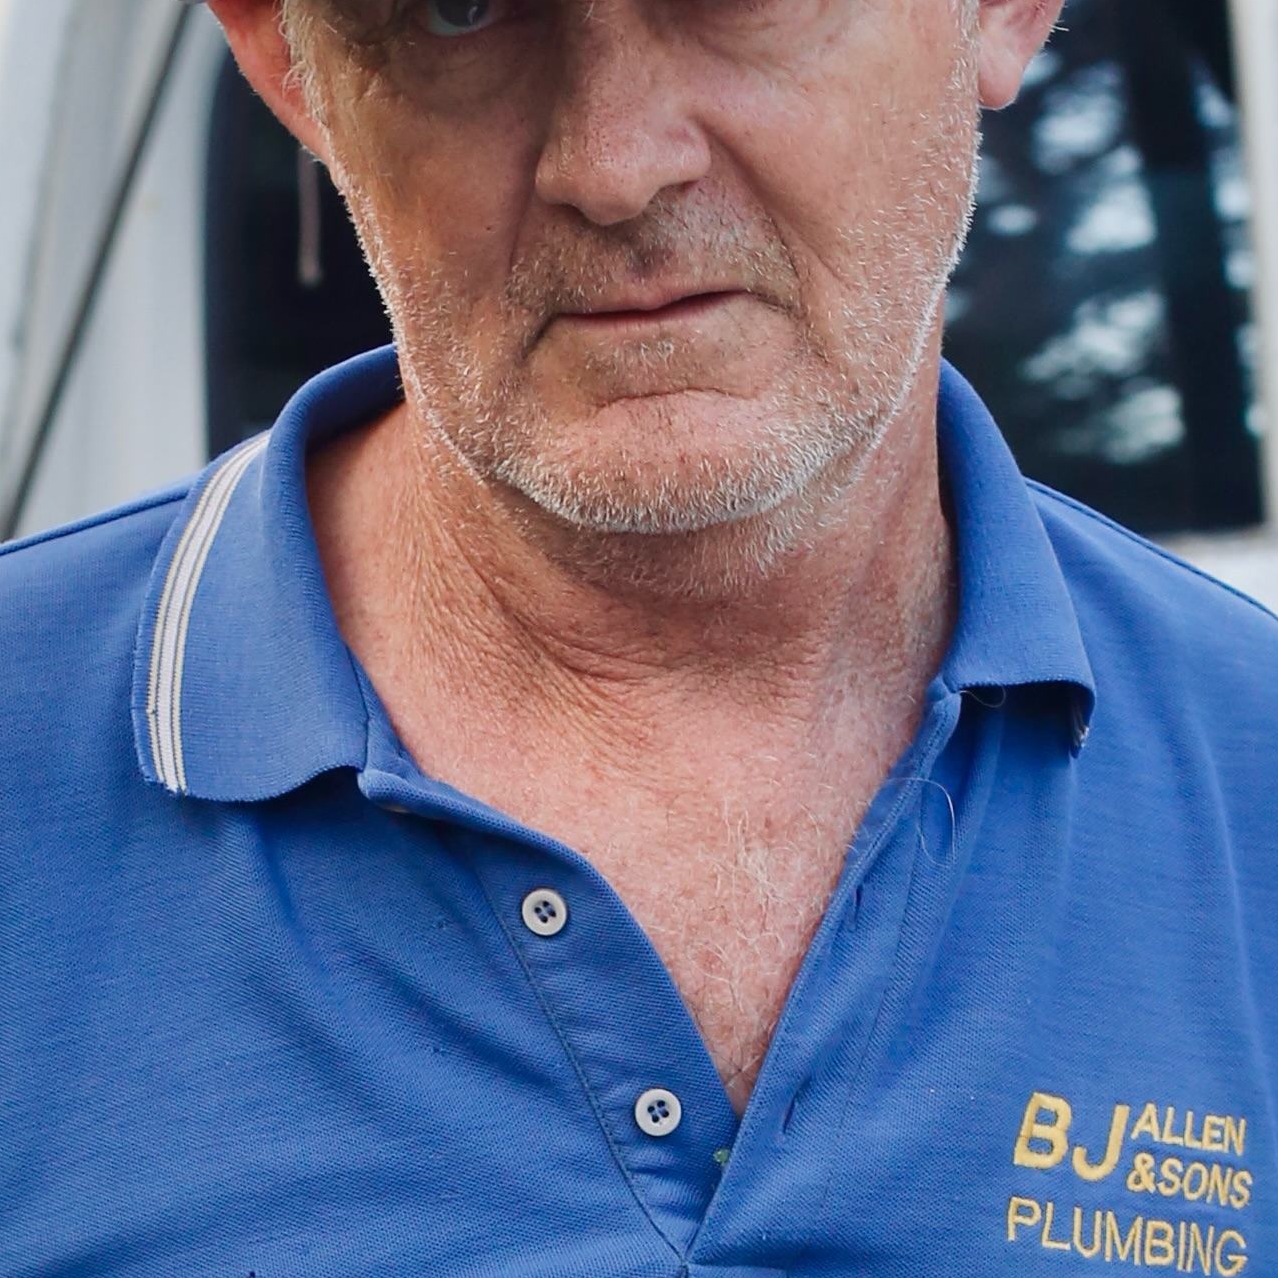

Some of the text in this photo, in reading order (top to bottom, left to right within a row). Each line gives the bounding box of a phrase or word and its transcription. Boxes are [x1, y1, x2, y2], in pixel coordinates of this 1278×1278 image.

[1131, 1102, 1246, 1157] ALLEN
[1126, 1152, 1253, 1209] &SONS
[1007, 1196, 1248, 1278] PLUMBING
